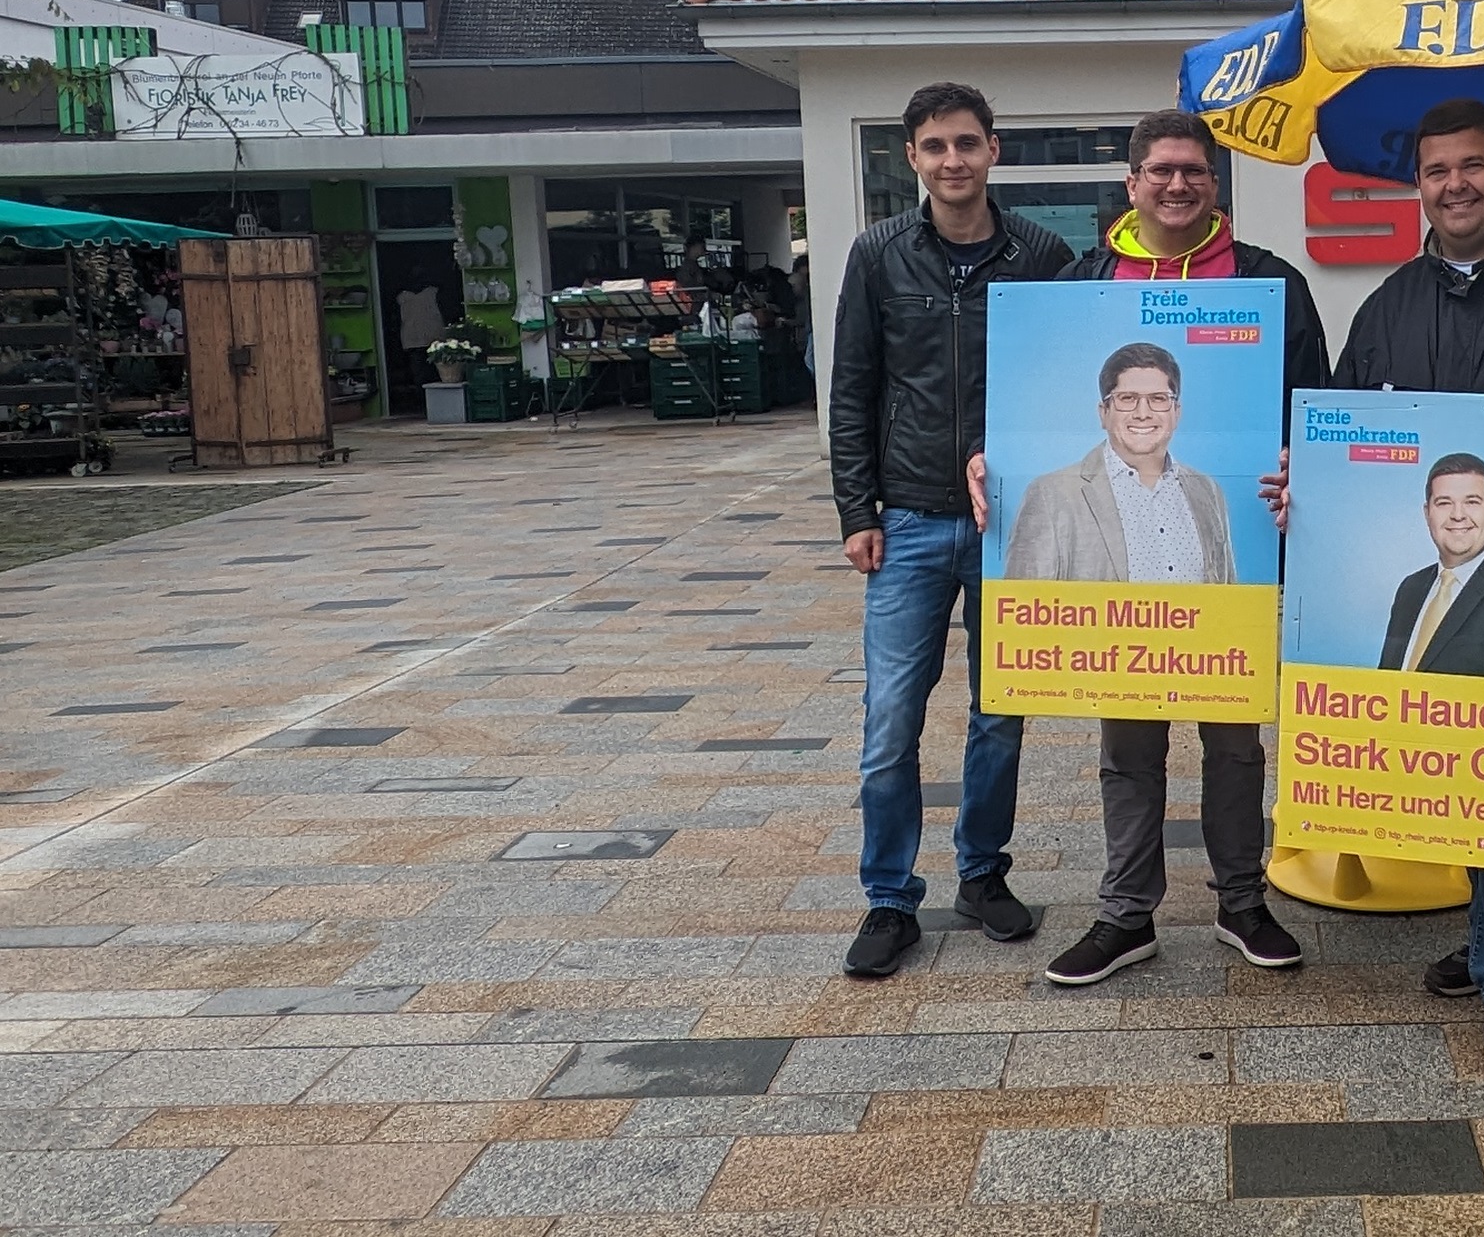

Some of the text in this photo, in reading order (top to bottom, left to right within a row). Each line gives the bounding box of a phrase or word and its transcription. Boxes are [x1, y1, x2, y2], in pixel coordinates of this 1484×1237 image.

[252, 71, 287, 81] Neuen
[291, 70, 322, 81] Pforte
[222, 85, 267, 107] TANJA
[273, 83, 307, 103] FREY
[1141, 290, 1188, 306] Freie
[1141, 308, 1260, 325] Demokraten
[1230, 329, 1258, 342] FDP
[1306, 407, 1351, 424] Freie
[1305, 426, 1419, 444] Demokraten
[1390, 448, 1417, 461] FDP
[996, 597, 1201, 629] Fabian Müller
[996, 642, 1255, 676] Lust auf Zukunft.
[1295, 681, 1389, 721] Marc
[1294, 732, 1390, 772] Stark
[1400, 747, 1461, 777] vor
[1292, 780, 1329, 806] Mit
[1337, 784, 1394, 812] Herz
[1401, 795, 1450, 817] und
